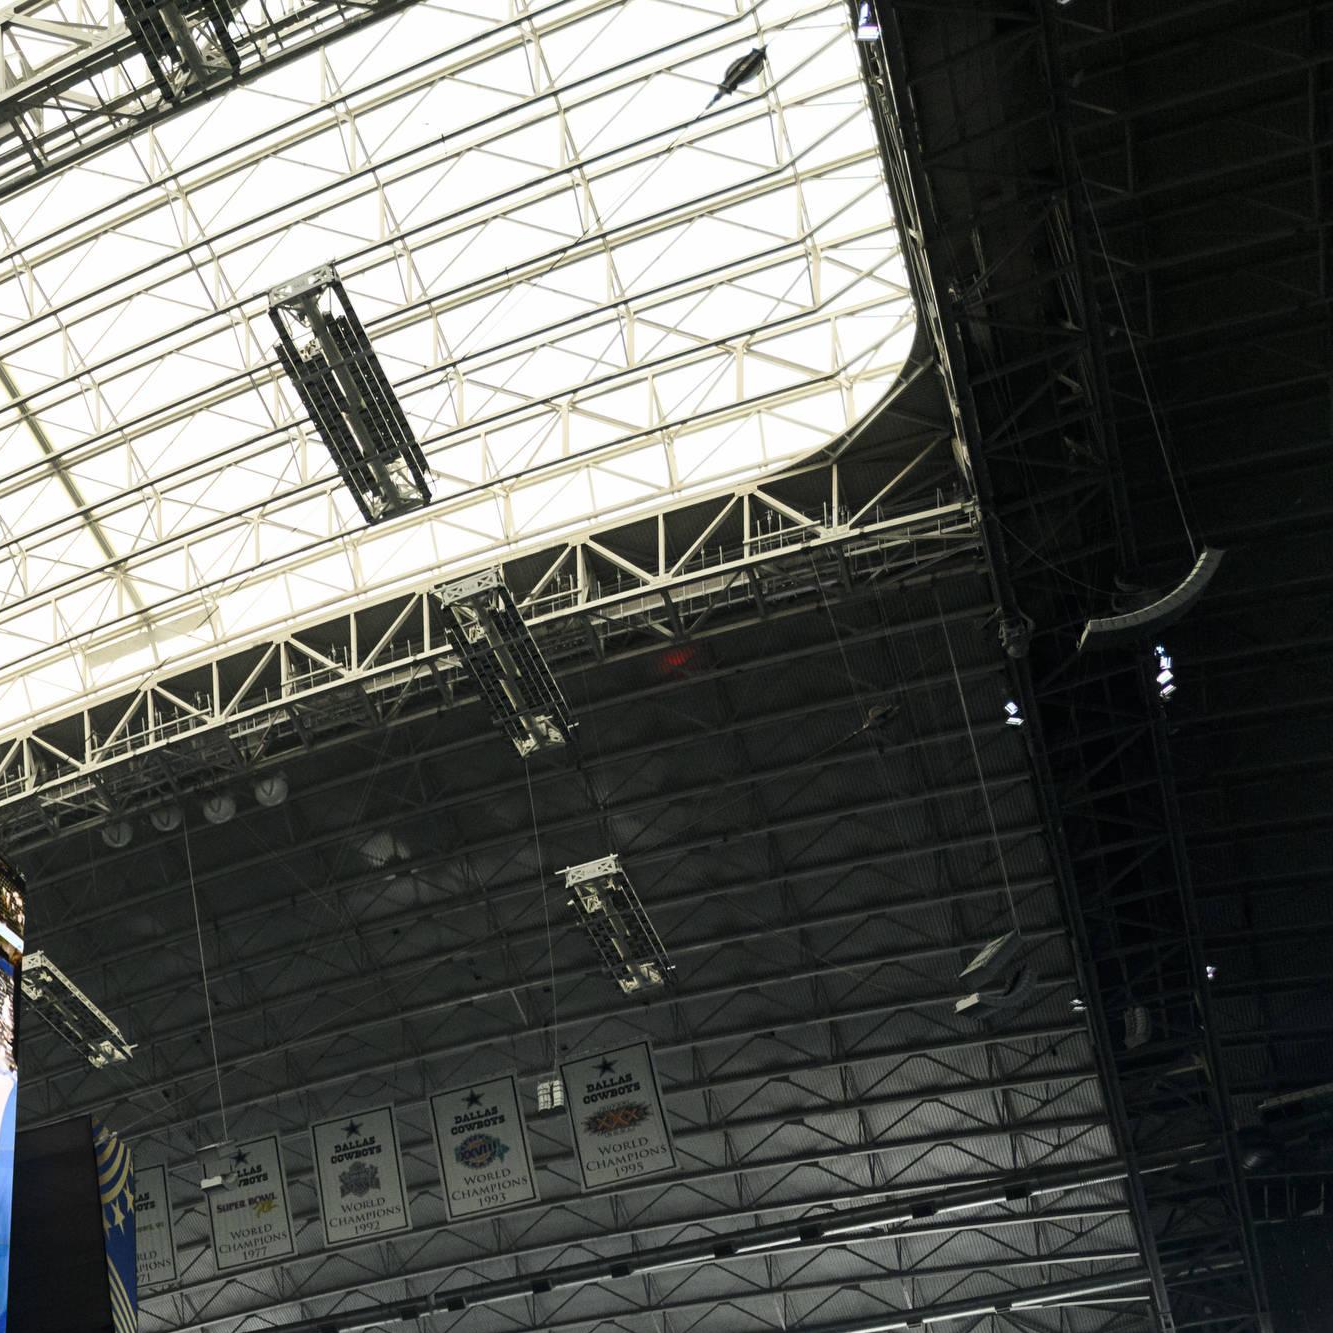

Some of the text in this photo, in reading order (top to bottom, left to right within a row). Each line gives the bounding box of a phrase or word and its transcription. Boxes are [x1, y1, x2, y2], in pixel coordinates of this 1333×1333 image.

[585, 1073, 633, 1093] DALLAS
[582, 1082, 641, 1105] COWBOYS
[454, 1106, 498, 1124] DALLAS
[450, 1114, 505, 1136] COWBOYS
[334, 1136, 376, 1153] DALLAS
[598, 1136, 649, 1157] WORLD
[330, 1144, 382, 1164] COWBOYS
[586, 1144, 668, 1172] CHAMPIONS
[236, 1165, 263, 1178] LLAS
[463, 1167, 511, 1186] WORLD
[614, 1161, 644, 1177] 1995
[238, 1172, 269, 1188] BOYS
[451, 1176, 529, 1201] CHAMPIONS
[340, 1197, 385, 1214] WORLD
[477, 1192, 507, 1207] 1993
[329, 1205, 401, 1229] CHAMPIONS
[230, 1223, 272, 1240] WORLD
[353, 1220, 382, 1235] 1992
[218, 1231, 287, 1254] CHAMPIONS
[242, 1247, 268, 1261] 1977
[137, 1258, 172, 1273] PIONS
